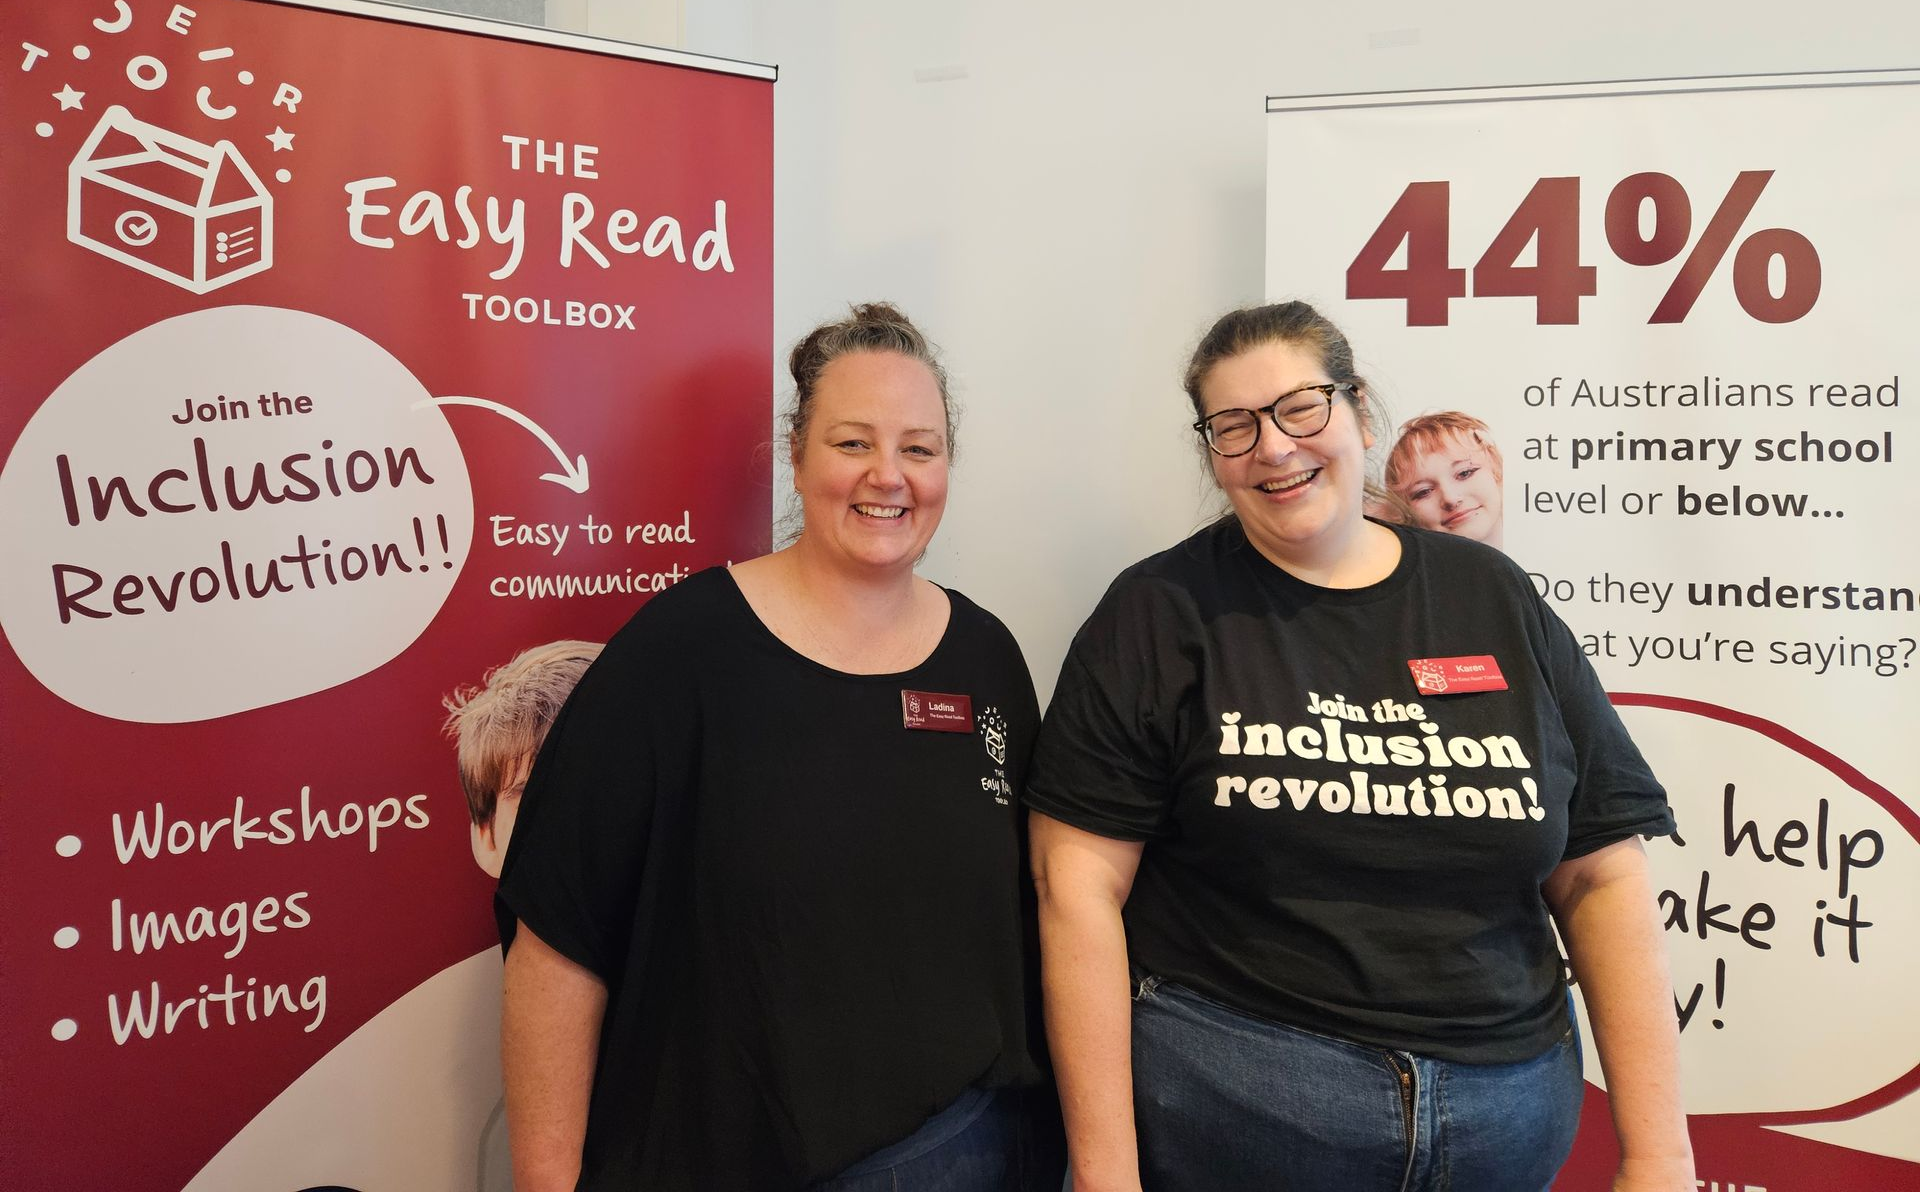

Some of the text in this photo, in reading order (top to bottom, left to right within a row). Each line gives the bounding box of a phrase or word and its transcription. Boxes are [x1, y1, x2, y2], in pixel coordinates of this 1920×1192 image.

[502, 134, 600, 180] THE
[344, 176, 735, 280] Easy Read
[1345, 169, 1822, 327] 44%
[462, 292, 637, 330] TOOLBOX
[172, 391, 314, 425] Join the
[1523, 376, 1901, 409] of Australians read
[1523, 430, 1893, 470] at primary school
[56, 436, 435, 527] Inclusion
[1523, 482, 1845, 518] level or below...
[489, 510, 696, 557] Easy to read
[52, 513, 453, 625] Revolution!!
[1587, 572, 1674, 614] they
[1687, 576, 1920, 612] understan
[1455, 664, 1486, 674] Karen
[1628, 632, 1755, 667] you're
[1768, 634, 1917, 677] saying?
[928, 701, 955, 713] Ladina
[1307, 691, 1427, 724] Join the
[1218, 711, 1532, 769] inclusion
[1213, 770, 1546, 822] revolution!
[112, 786, 430, 864] Workshops
[1723, 783, 1885, 900] help
[111, 891, 312, 959] Images
[1657, 870, 1874, 964] ake it
[107, 973, 327, 1045] Writing
